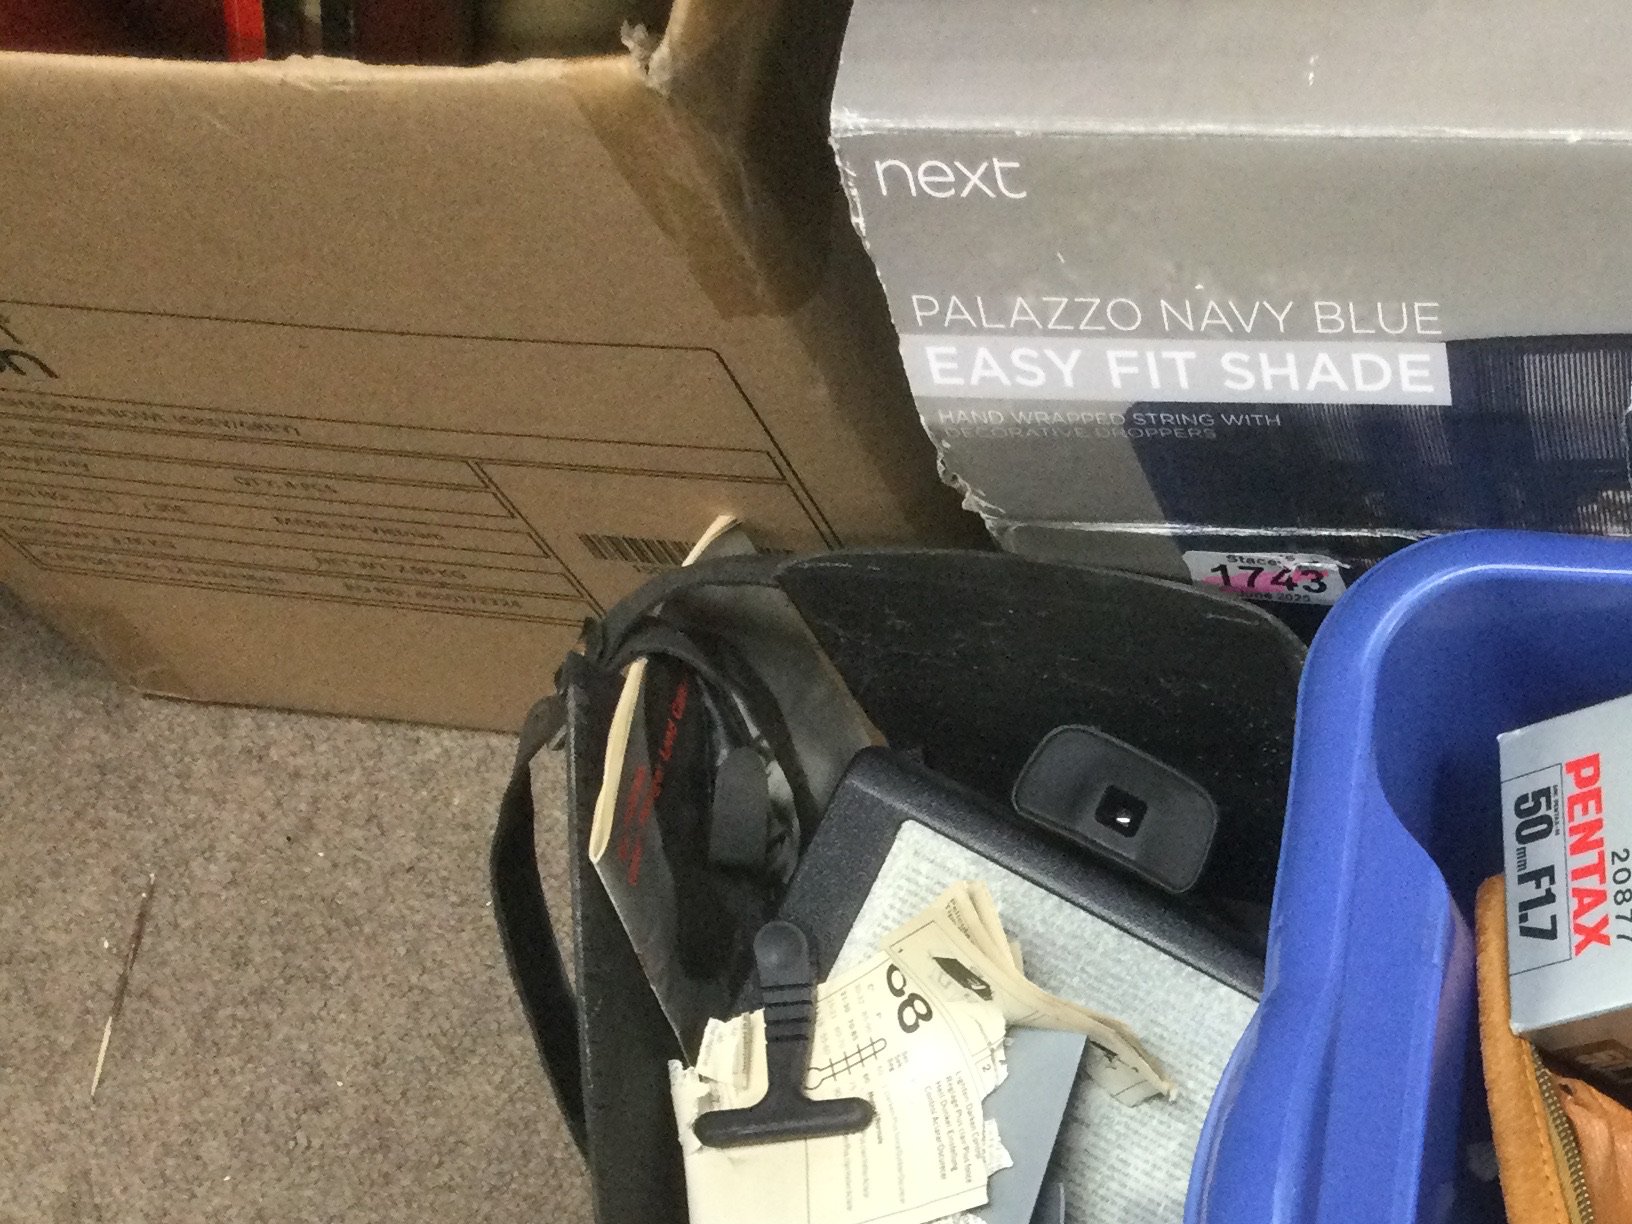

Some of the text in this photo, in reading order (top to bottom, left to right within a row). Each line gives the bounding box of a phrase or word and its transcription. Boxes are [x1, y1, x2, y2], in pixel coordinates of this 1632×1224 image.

[875, 157, 1027, 200] next
[910, 294, 1443, 336] PALAZZO NAVY BLUE
[925, 345, 1435, 393] EASY FIT SHADE
[938, 409, 1283, 428] HAND WRAPPED STRING WITH
[1210, 564, 1328, 594] 1743
[1564, 752, 1612, 957] PENTAX
